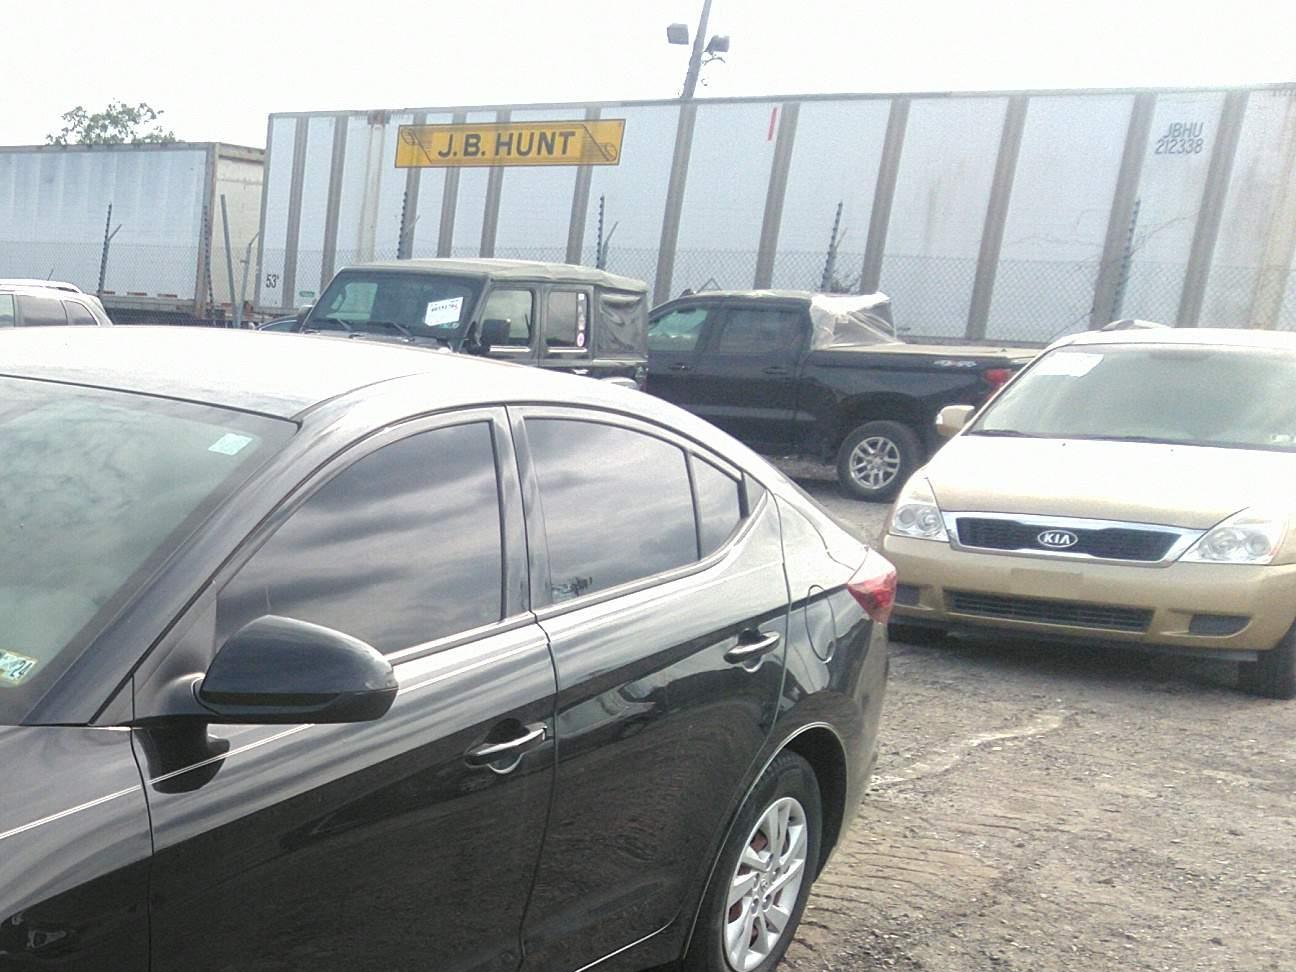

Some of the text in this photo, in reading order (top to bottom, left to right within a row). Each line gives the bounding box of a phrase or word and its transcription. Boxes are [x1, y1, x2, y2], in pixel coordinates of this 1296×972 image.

[1163, 122, 1204, 138] JBHU
[494, 130, 576, 157] HUNT
[1154, 138, 1204, 154] 212338
[1044, 532, 1070, 544] KIA
